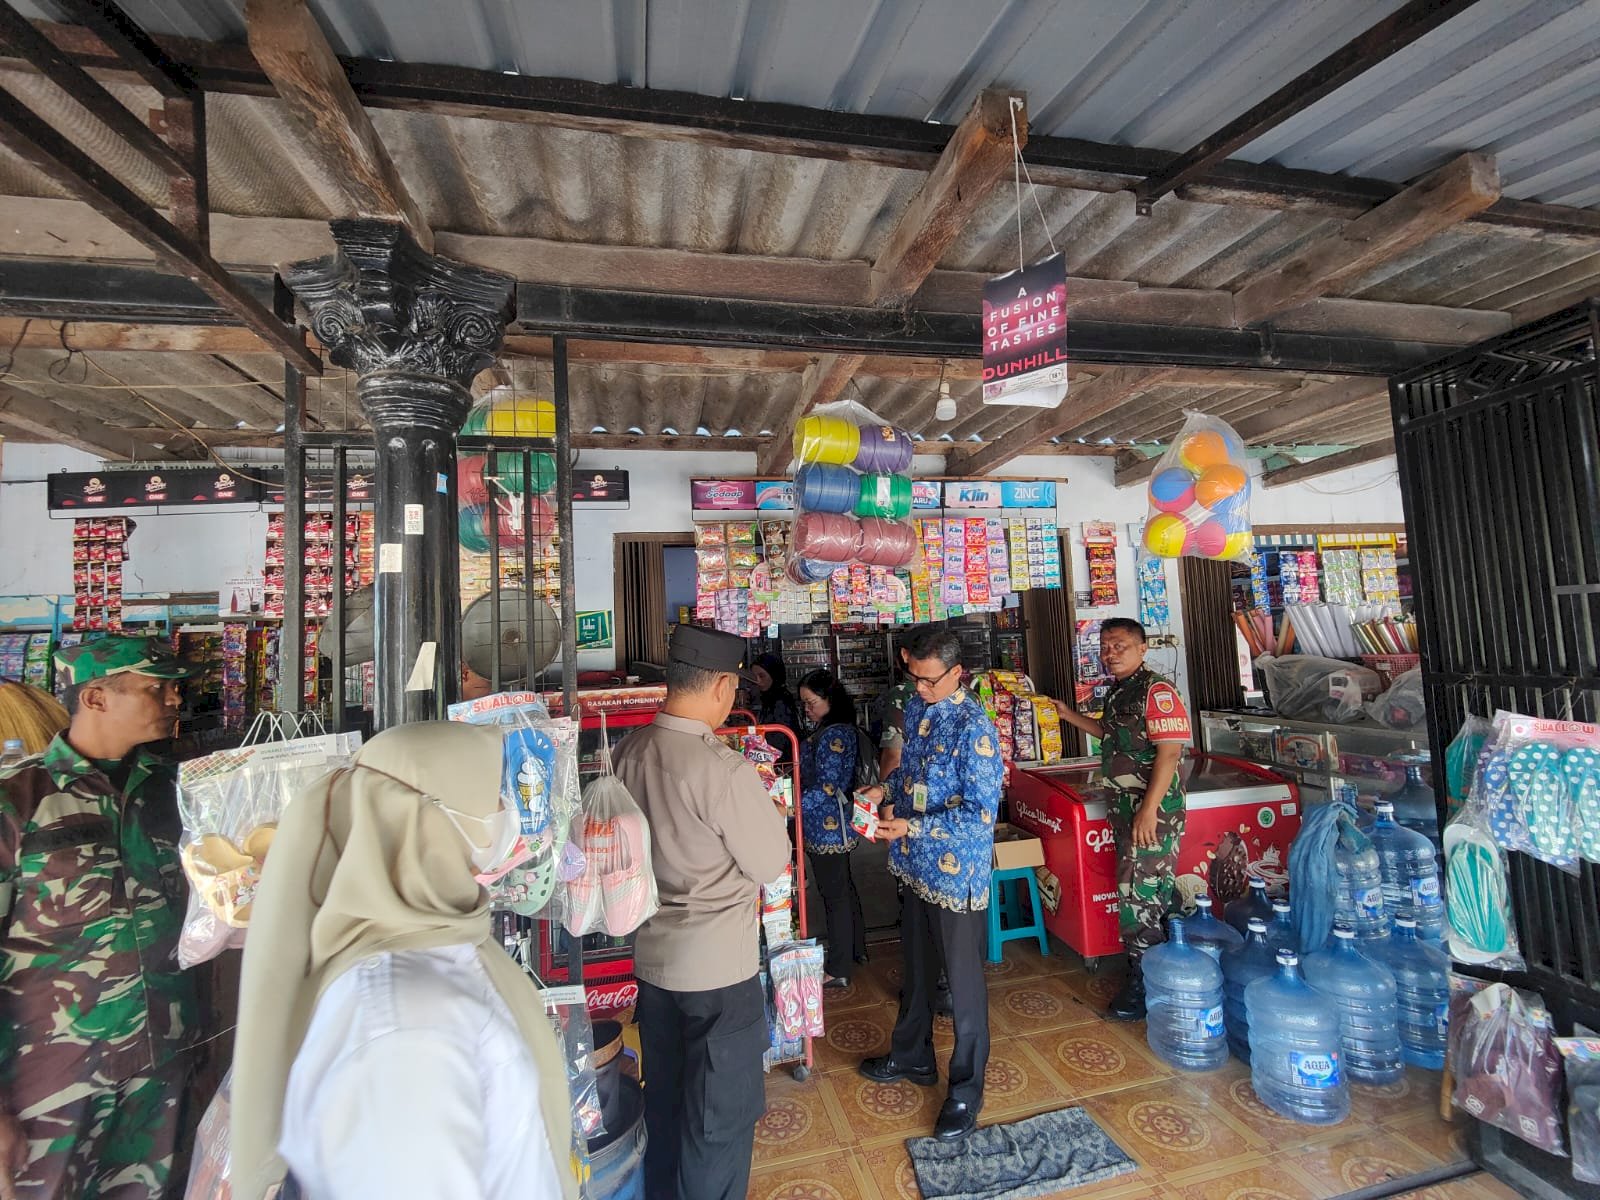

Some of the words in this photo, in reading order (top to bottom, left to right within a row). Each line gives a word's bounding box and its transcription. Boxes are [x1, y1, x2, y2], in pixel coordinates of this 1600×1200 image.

[1018, 287, 1027, 298] A
[990, 291, 1057, 322] FUSION
[987, 320, 1009, 337] OF
[1018, 306, 1060, 329] FINE
[990, 323, 1057, 351] TASTES
[982, 347, 1068, 381] DUNHILL
[706, 490, 743, 499] Sedaap
[959, 489, 989, 502] Klin
[1014, 487, 1040, 499] ZINC
[473, 693, 536, 713] SWALLOW
[587, 699, 622, 707] RASAKAN
[1148, 717, 1190, 735] BABINSA
[1085, 828, 1115, 853] Gli
[1303, 1059, 1330, 1071] AQUA
